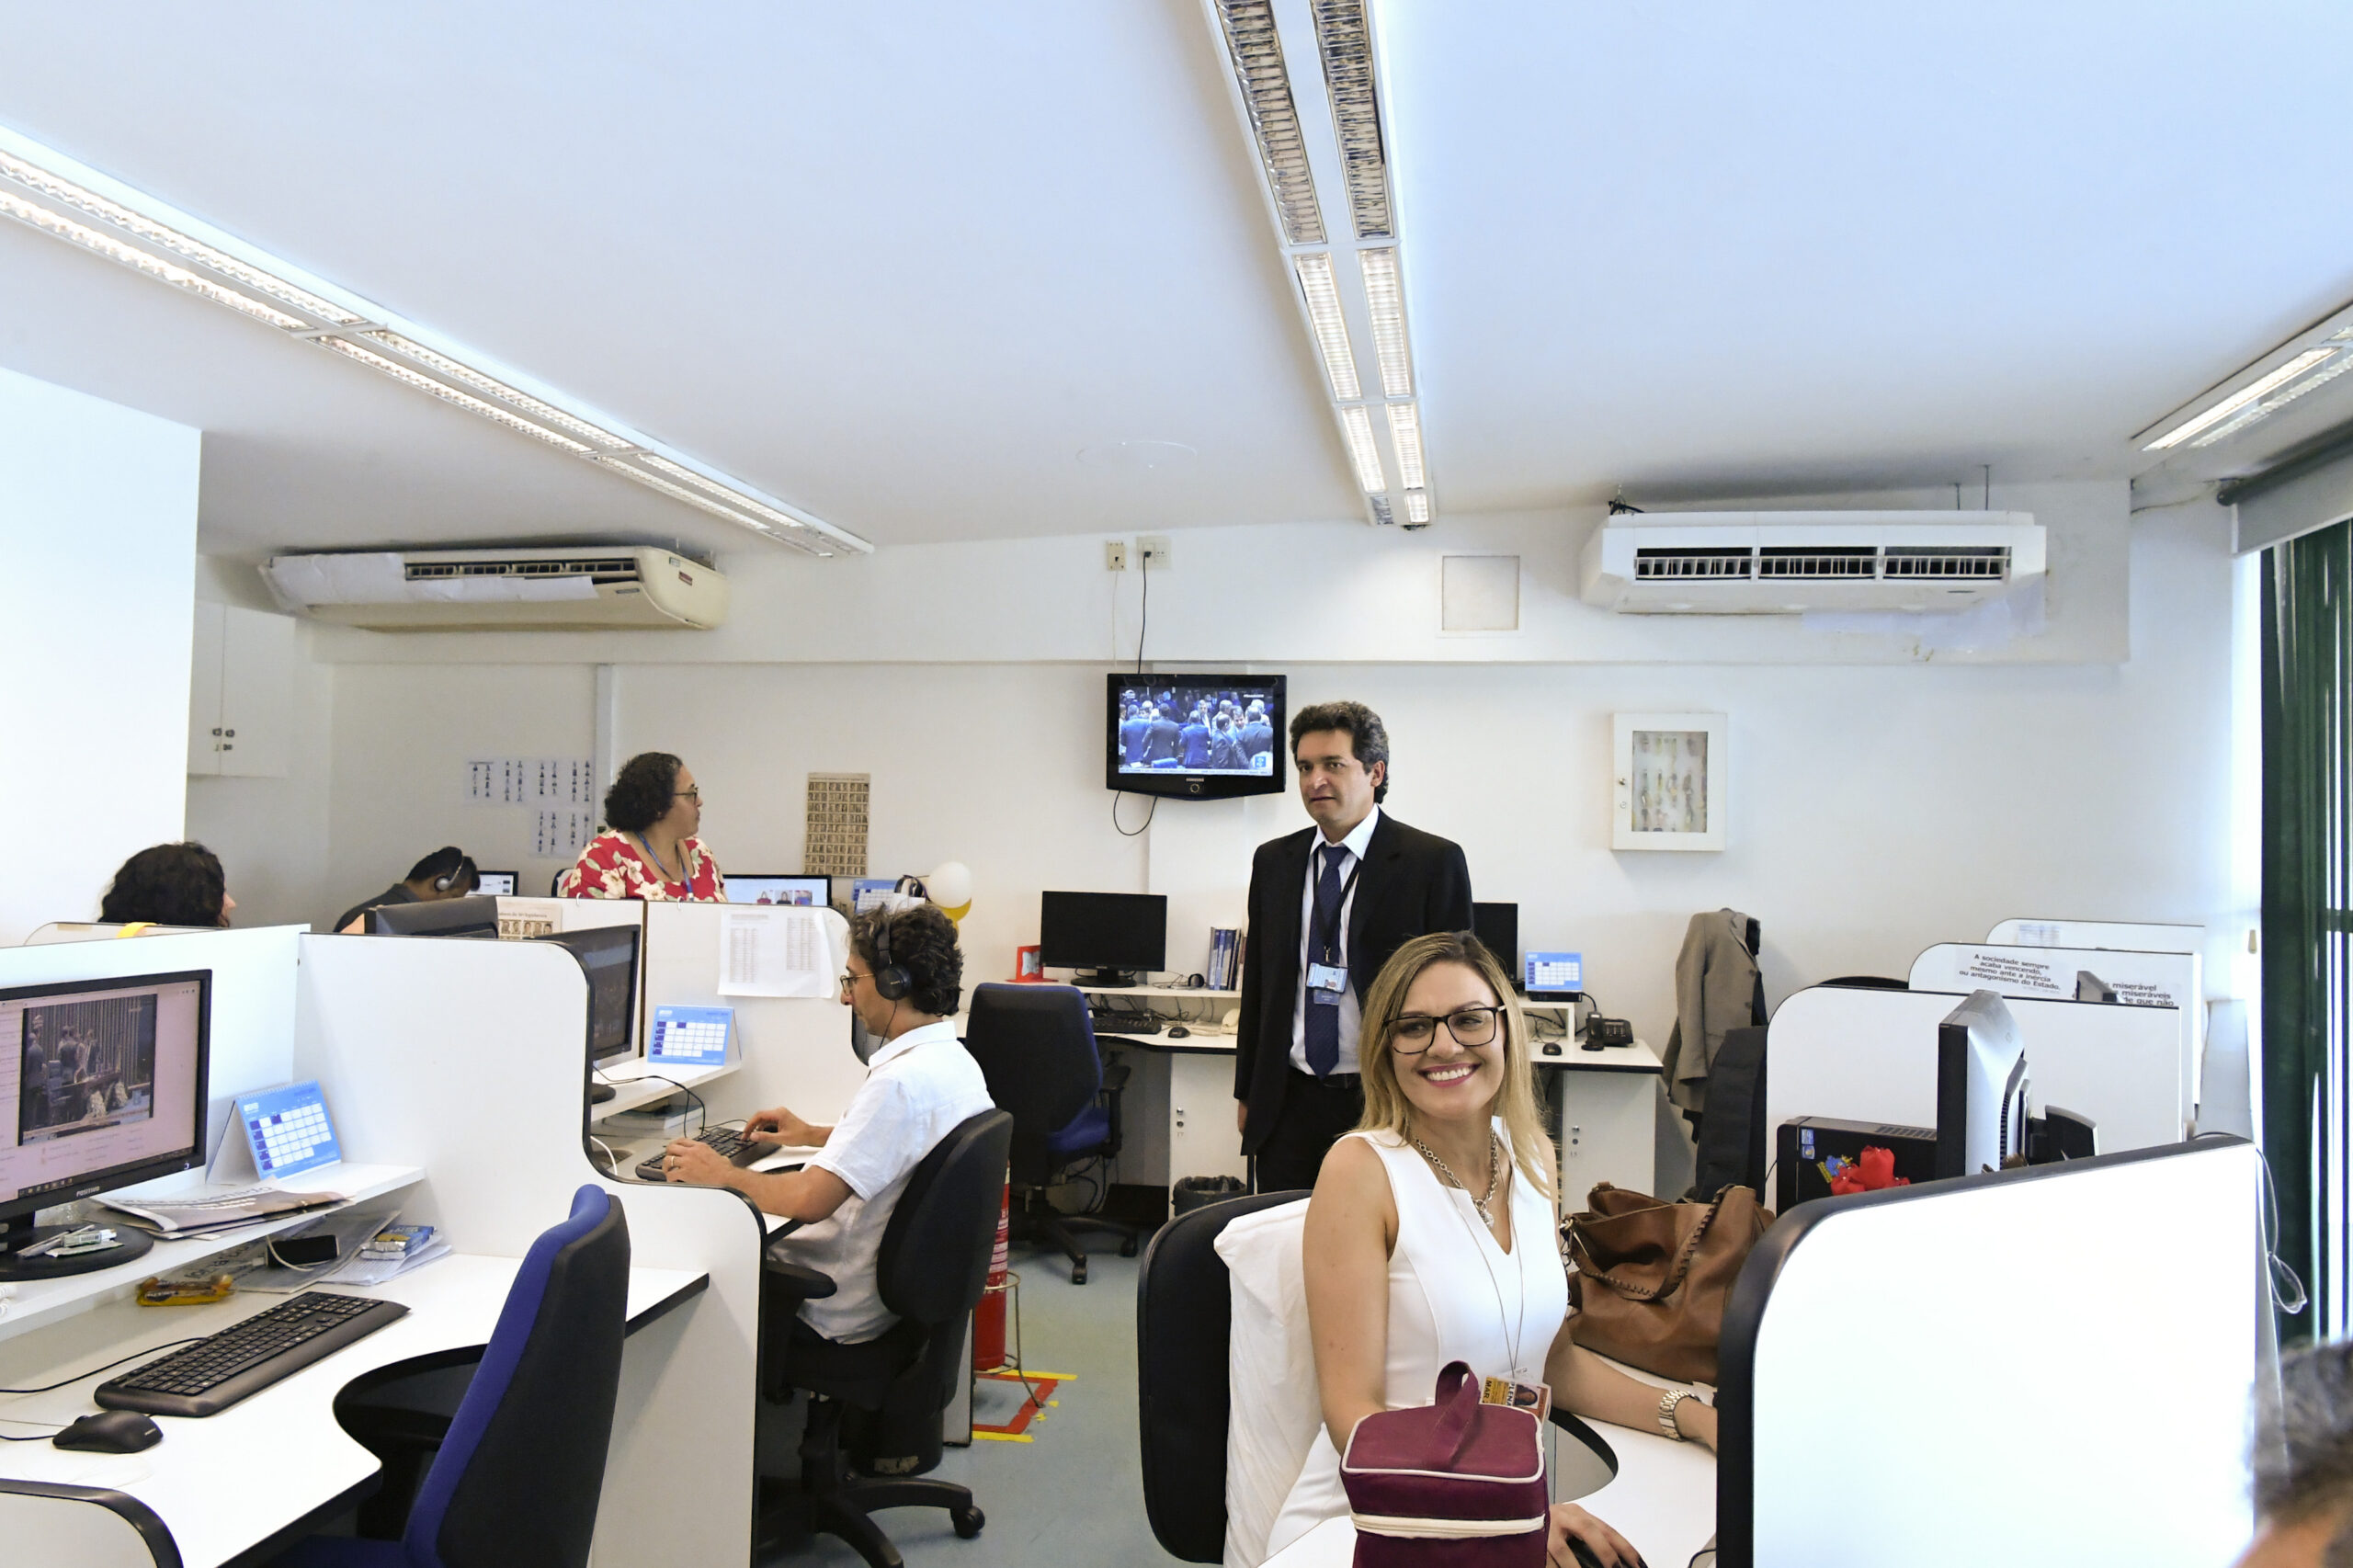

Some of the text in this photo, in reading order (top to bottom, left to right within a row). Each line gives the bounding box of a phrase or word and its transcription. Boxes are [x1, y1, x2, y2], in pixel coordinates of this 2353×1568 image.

[1982, 955, 2018, 965] sociedade
[2021, 961, 2050, 970] sempre
[1970, 966, 1997, 974] mesmo
[2026, 973, 2052, 983] inércia
[1971, 971, 2019, 983] antagonismo
[2033, 982, 2061, 990] Estado.
[2112, 983, 2156, 991] miserável
[2121, 990, 2172, 999] miseráveis
